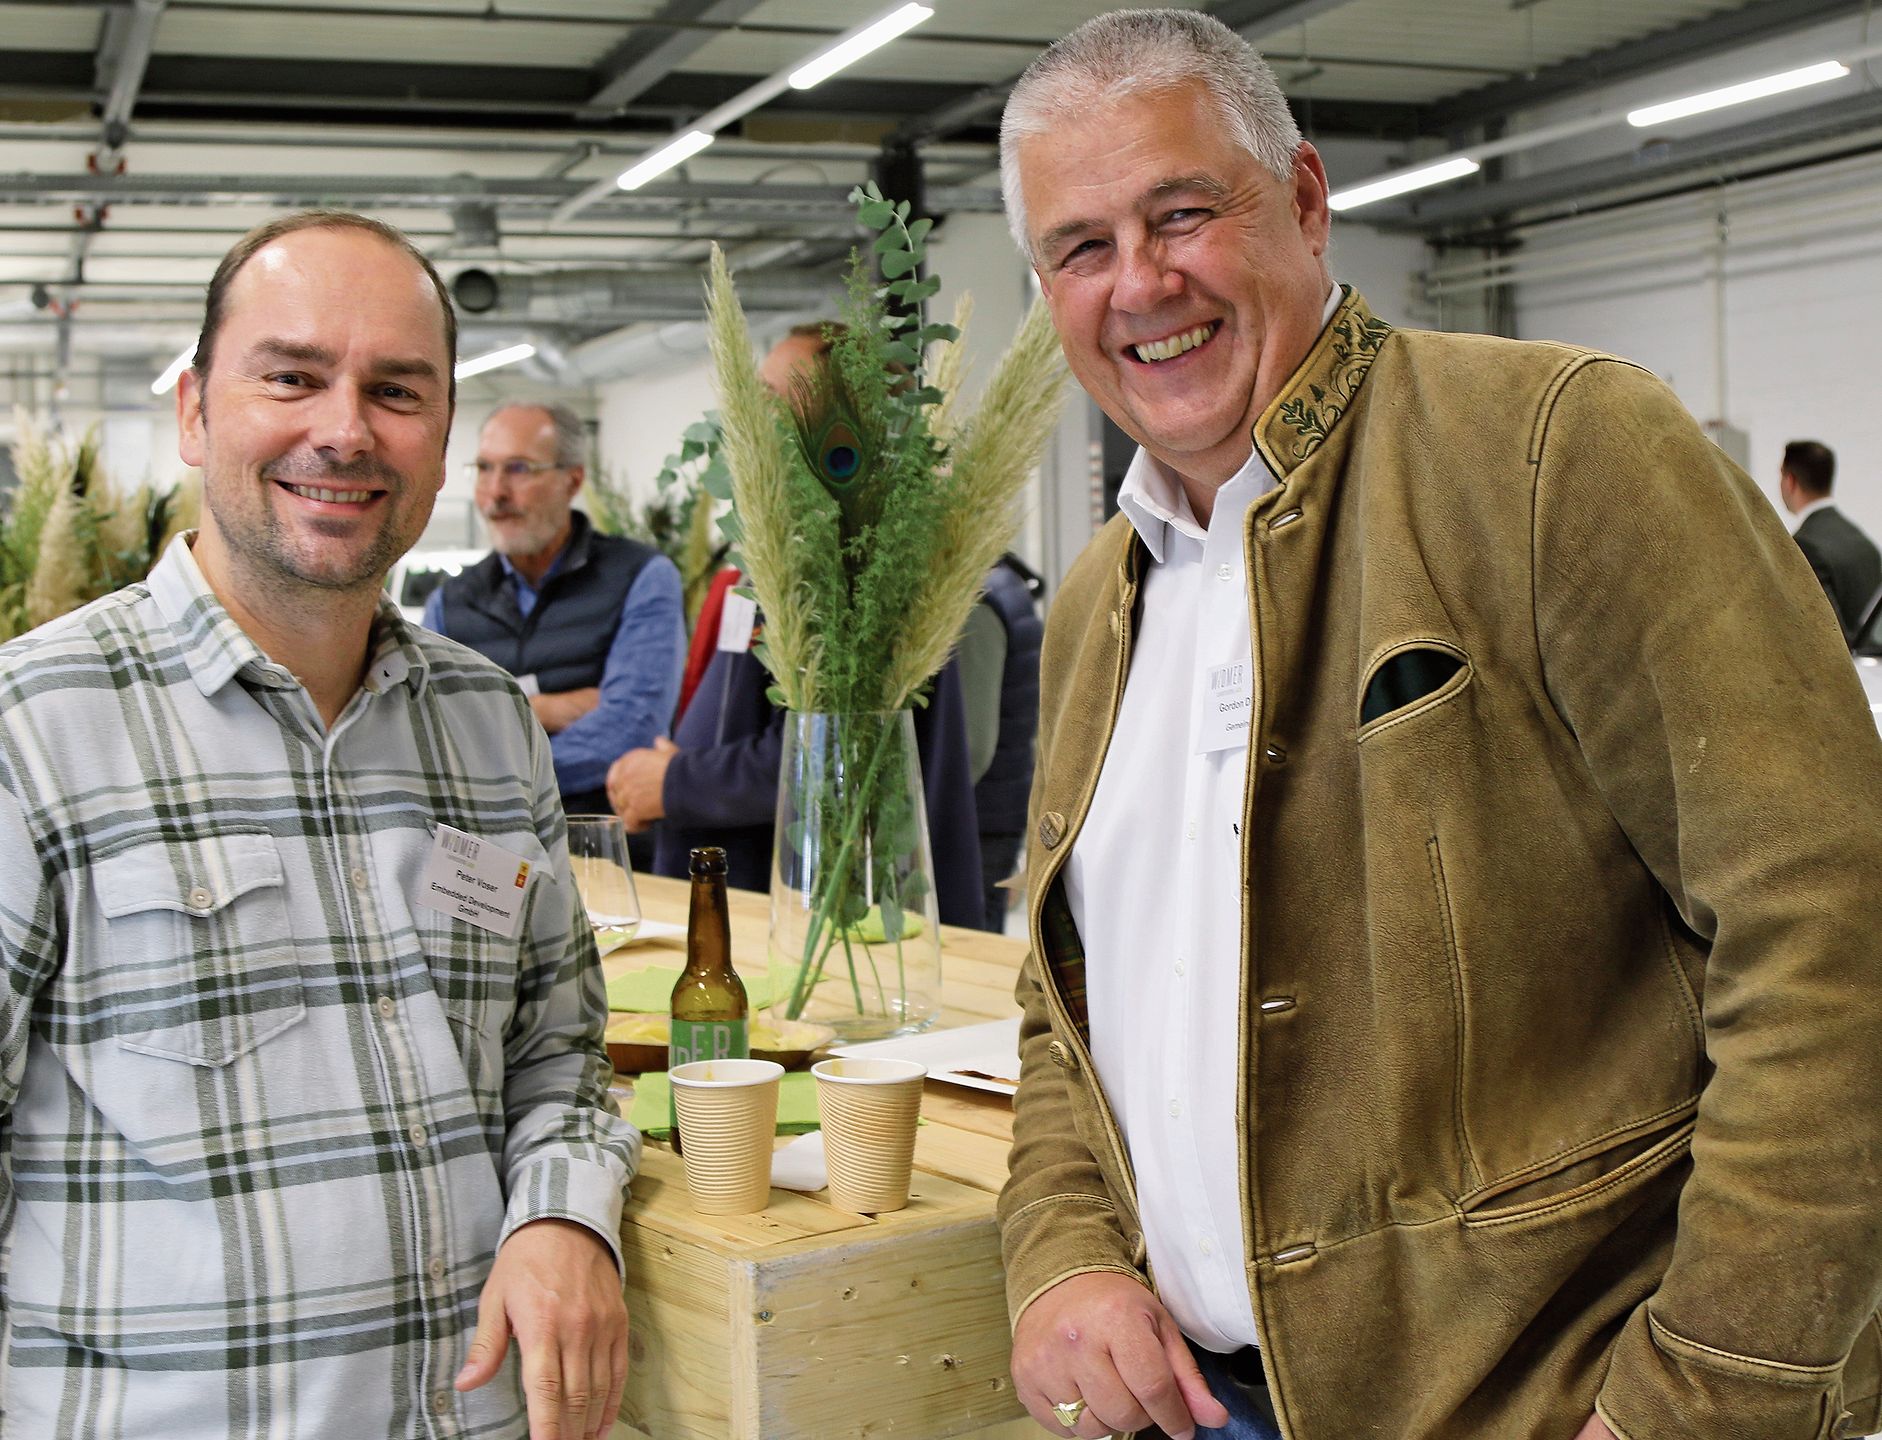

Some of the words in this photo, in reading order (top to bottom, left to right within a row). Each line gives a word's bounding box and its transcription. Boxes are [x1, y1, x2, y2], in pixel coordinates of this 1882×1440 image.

[1218, 700, 1244, 713] Gordon
[456, 869, 476, 884] Peter
[476, 878, 498, 893] Voser
[431, 882, 468, 902] Embedded
[468, 896, 511, 919] Development
[458, 904, 480, 918] GmbH
